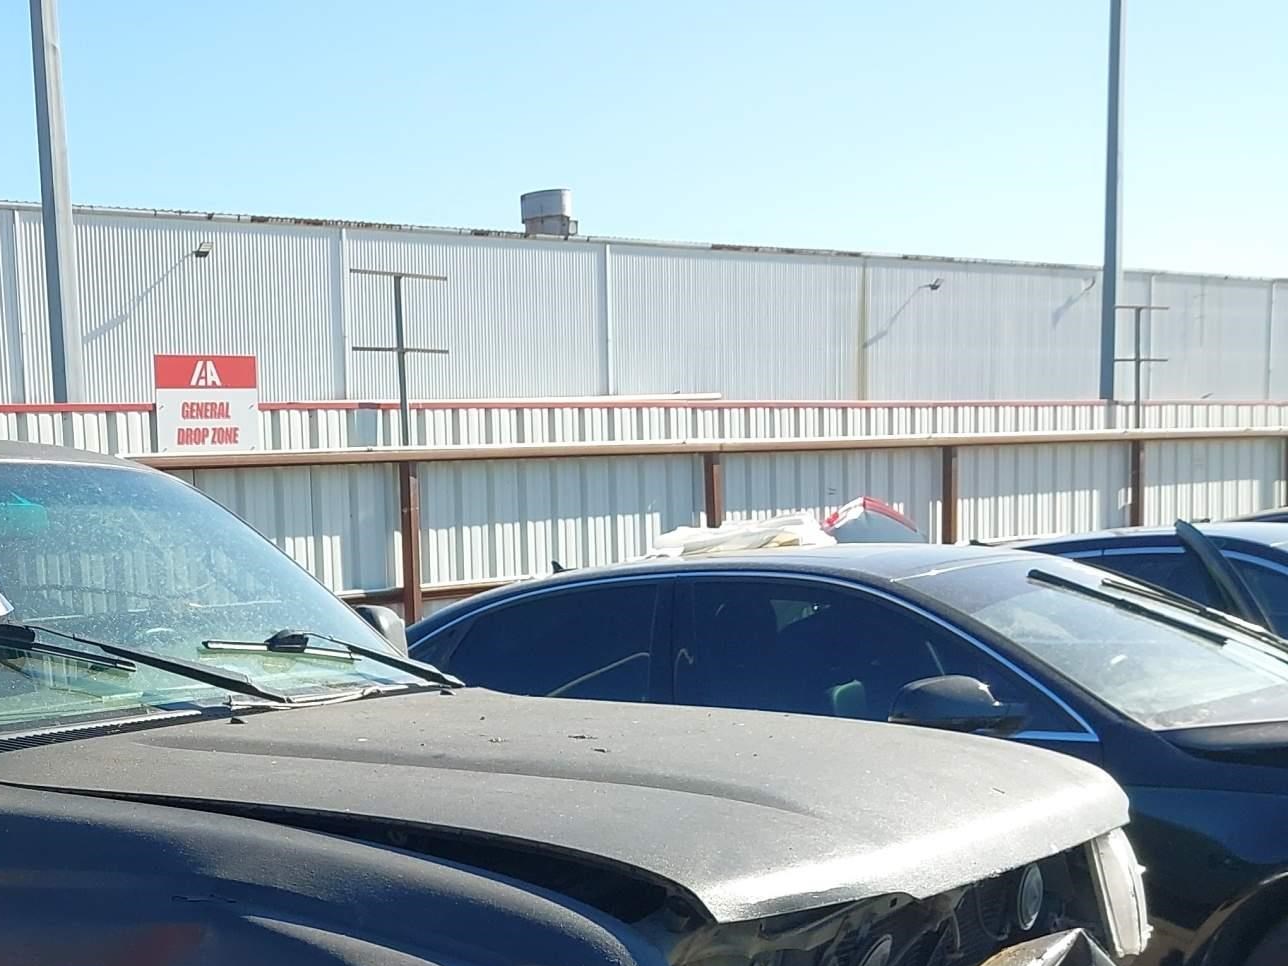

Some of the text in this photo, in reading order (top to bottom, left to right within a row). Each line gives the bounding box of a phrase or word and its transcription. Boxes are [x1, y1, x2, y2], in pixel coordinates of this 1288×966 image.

[181, 401, 231, 420] GENERAL
[177, 427, 240, 446] DROP ZONE
